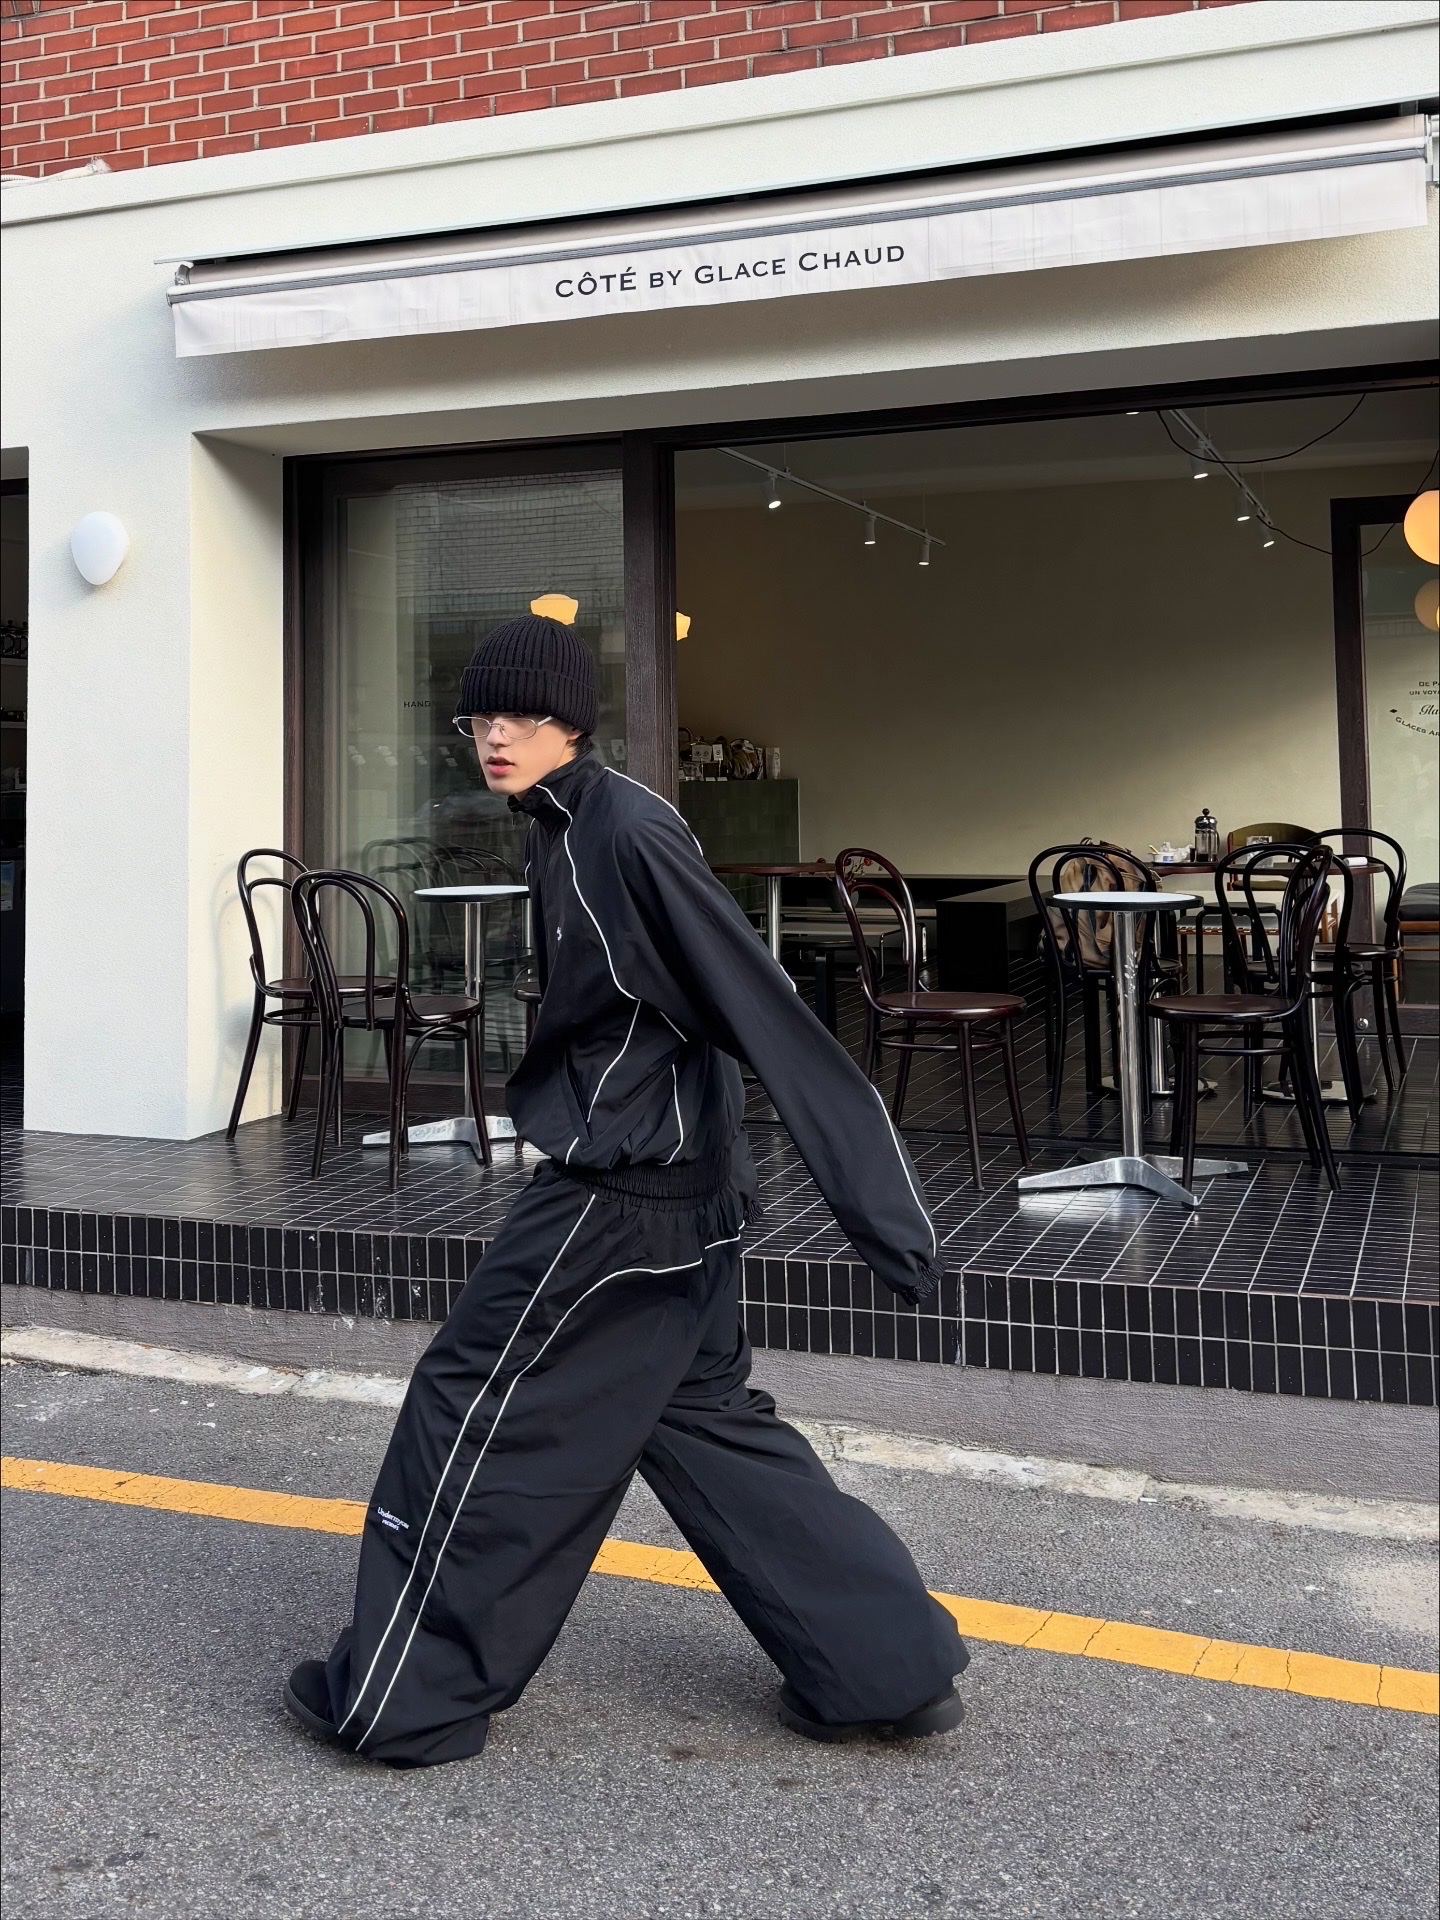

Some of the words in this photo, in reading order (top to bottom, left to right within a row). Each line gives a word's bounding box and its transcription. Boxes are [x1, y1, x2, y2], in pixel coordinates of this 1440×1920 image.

[555, 267, 637, 298] CÔTÉ
[649, 269, 682, 289] BY
[694, 258, 786, 284] GLACE
[798, 245, 905, 272] CHAUD
[1395, 716, 1426, 734] GLACES
